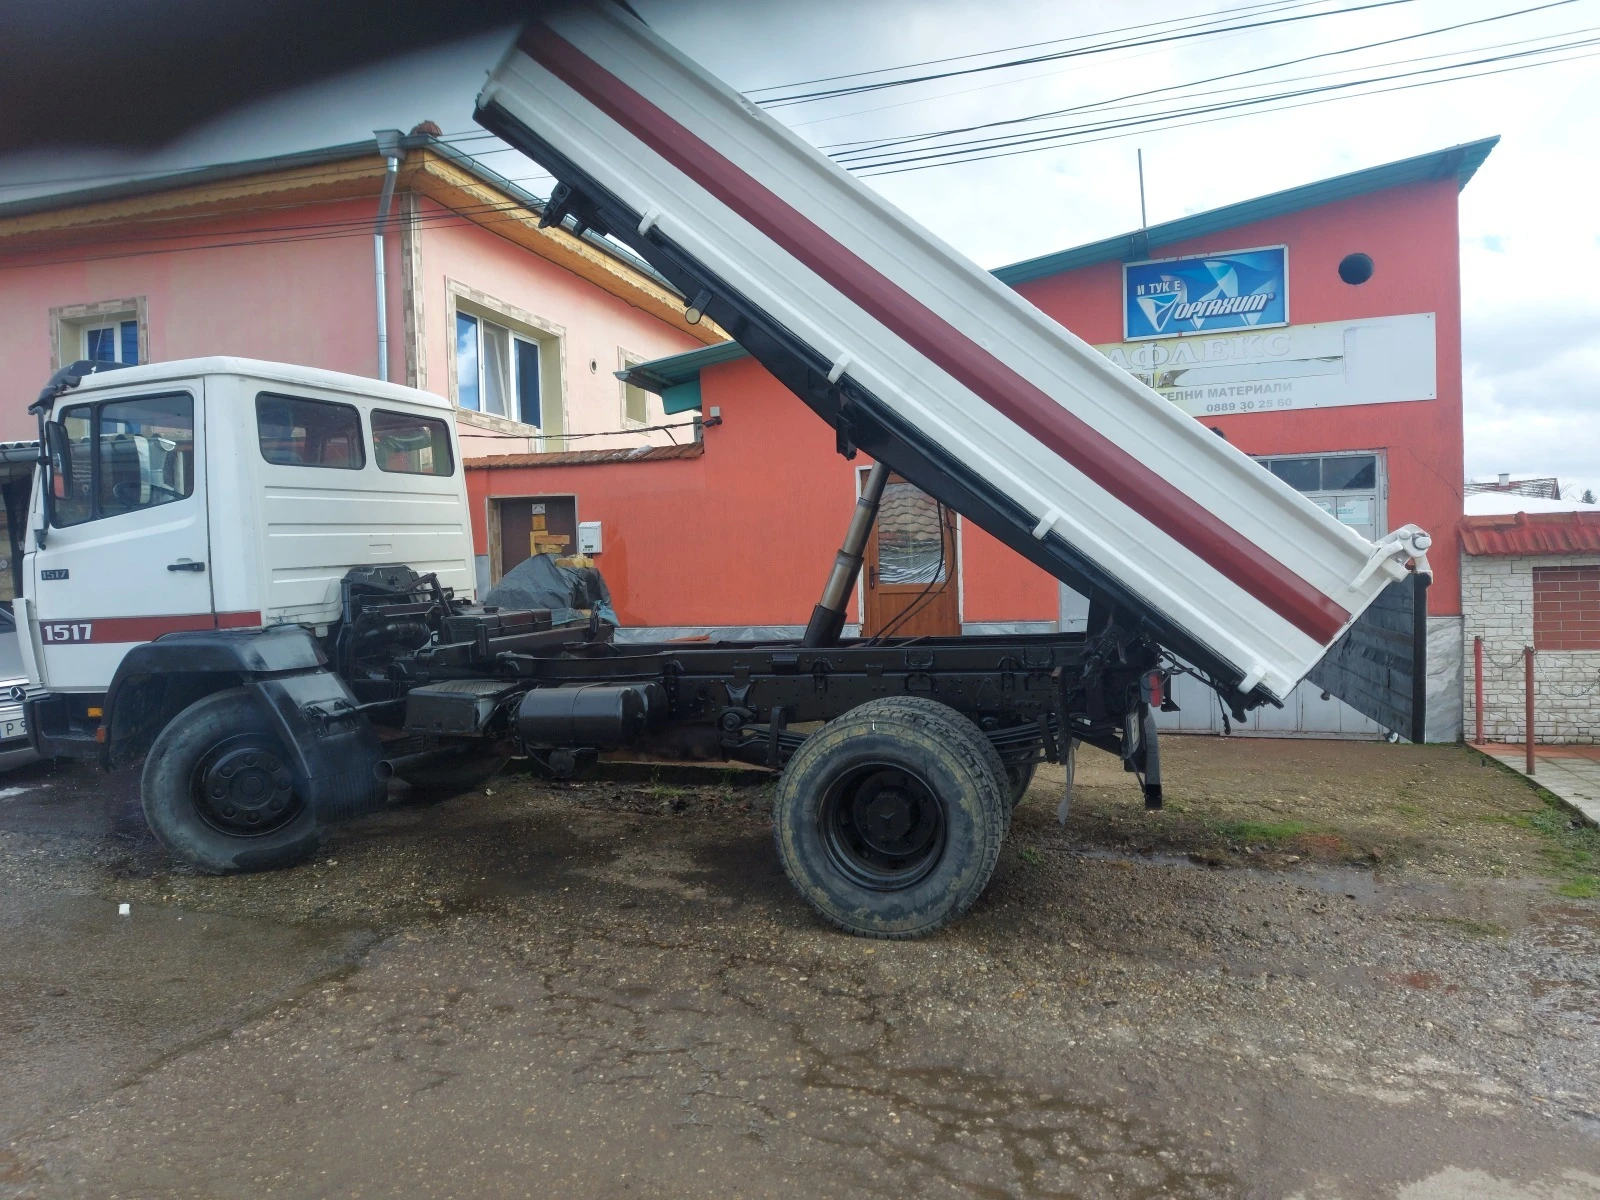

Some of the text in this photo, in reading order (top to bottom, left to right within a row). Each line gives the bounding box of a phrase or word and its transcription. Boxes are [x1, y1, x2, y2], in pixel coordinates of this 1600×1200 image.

[1137, 280, 1181, 295] И ТУК Е
[1207, 382, 1292, 398] МАТЕРИАЛИ
[1206, 402, 1236, 412] 0889
[1240, 401, 1254, 410] 30
[1258, 399, 1273, 408] 25
[42, 570, 67, 579] 1517
[44, 623, 92, 641] 1517
